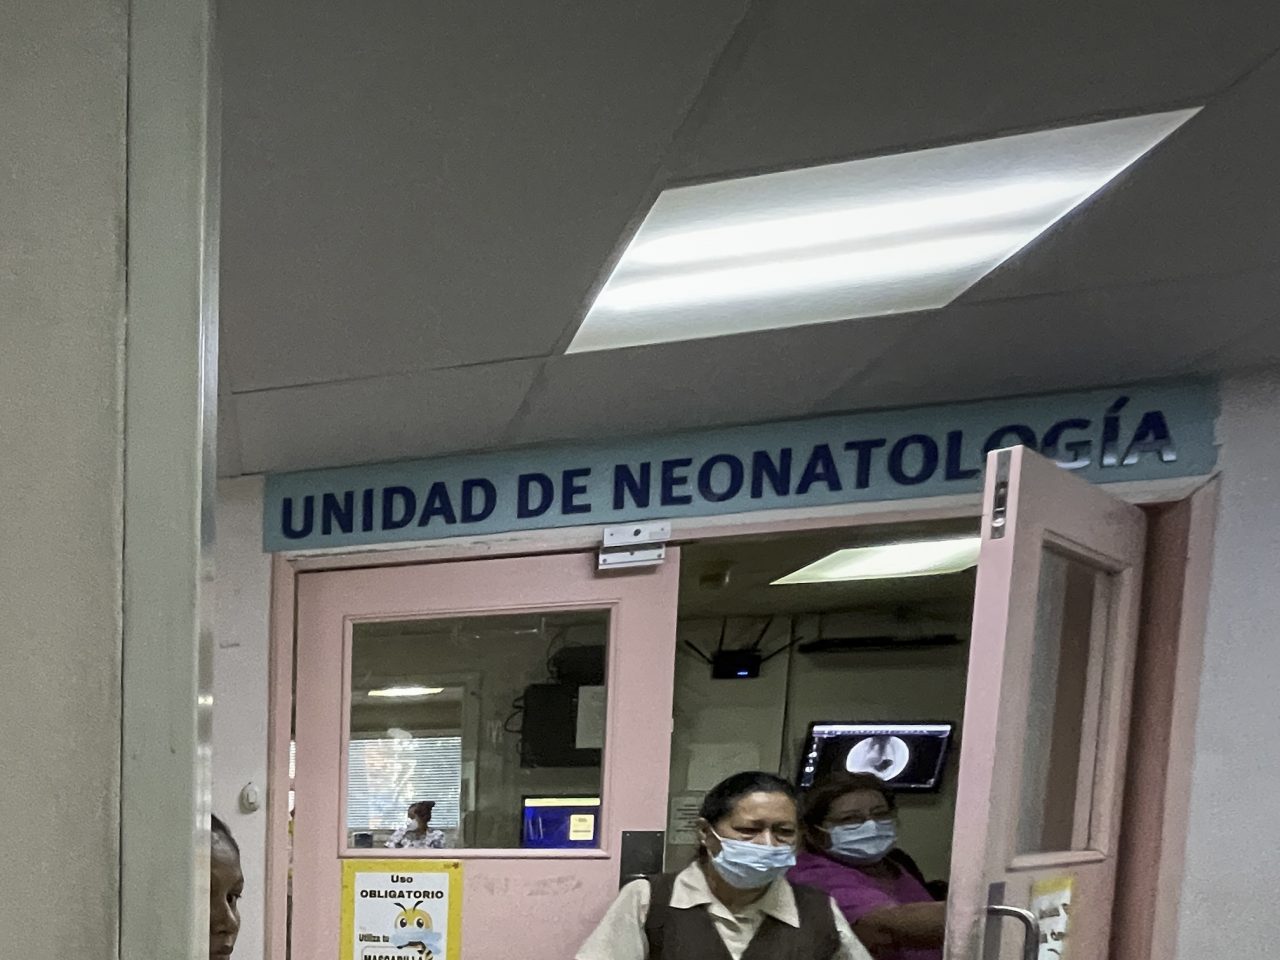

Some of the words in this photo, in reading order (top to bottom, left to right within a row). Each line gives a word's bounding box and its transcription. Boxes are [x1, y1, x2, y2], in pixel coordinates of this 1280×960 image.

[281, 477, 497, 539] UNIDAD
[516, 467, 592, 520] DE
[360, 890, 444, 899] OBLIGATORIO
